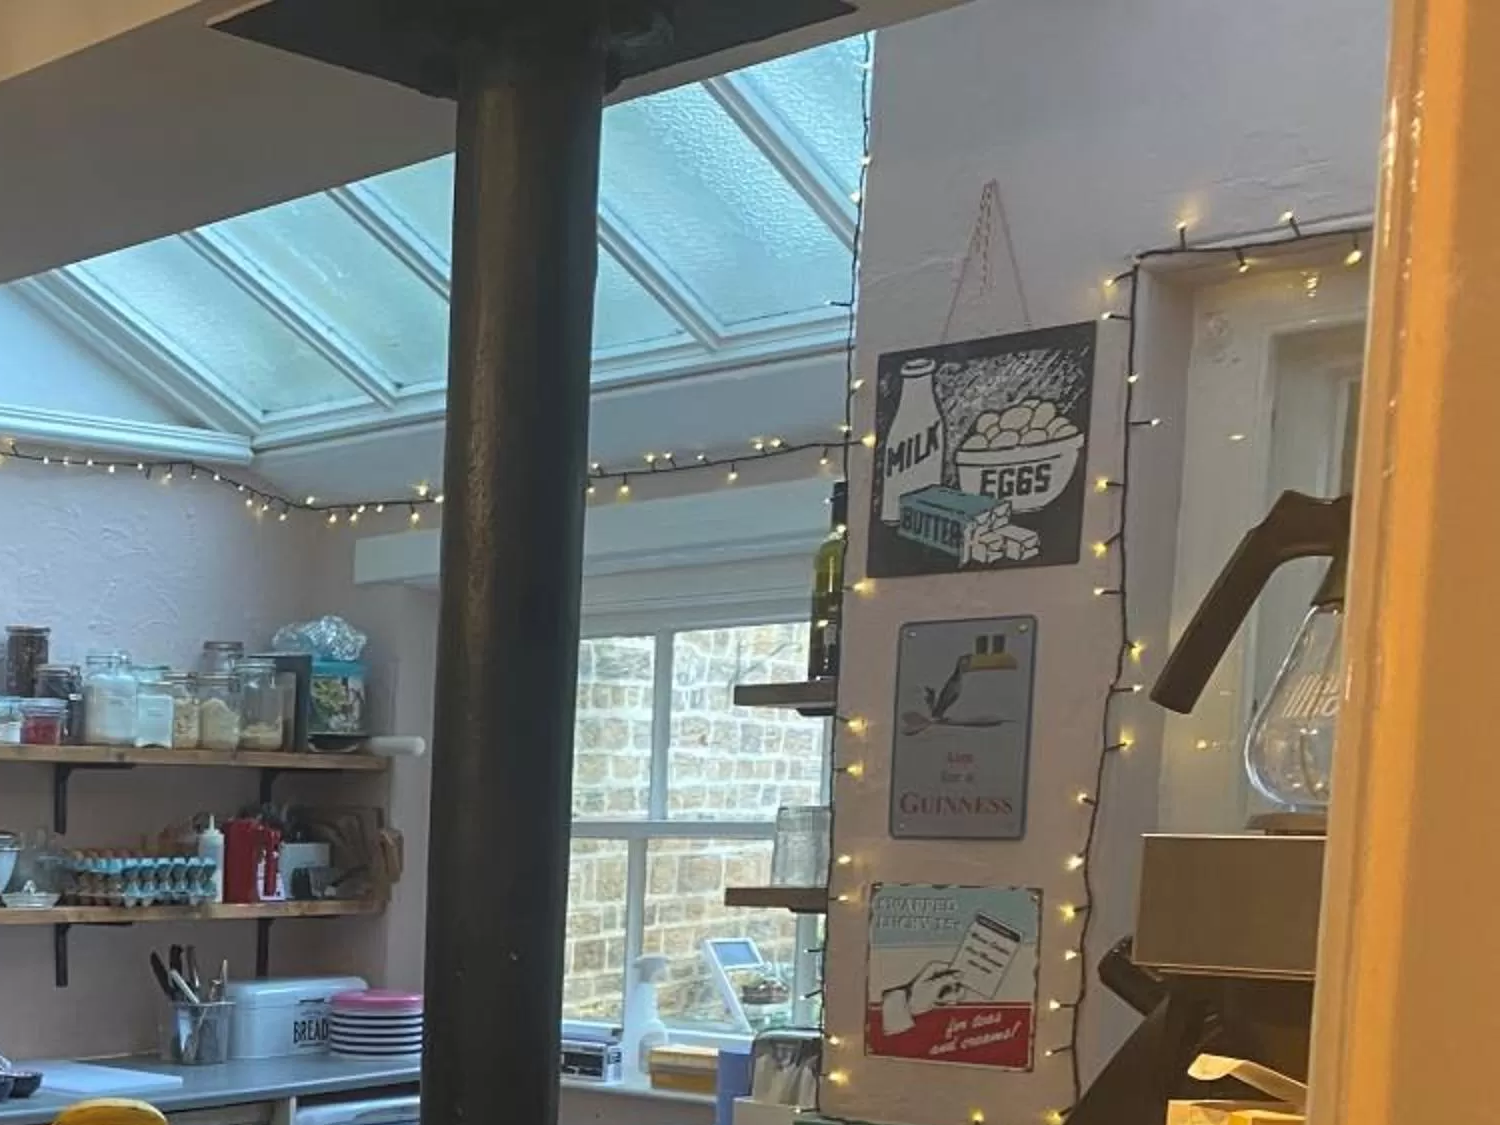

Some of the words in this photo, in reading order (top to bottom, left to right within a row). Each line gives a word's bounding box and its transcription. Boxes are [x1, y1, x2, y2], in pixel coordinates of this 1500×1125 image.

[887, 420, 941, 477] MILK
[980, 463, 1052, 497] EGGS
[902, 507, 964, 547] BUTTER
[900, 791, 1013, 815] GUINNESS
[293, 1019, 329, 1044] BREAD
